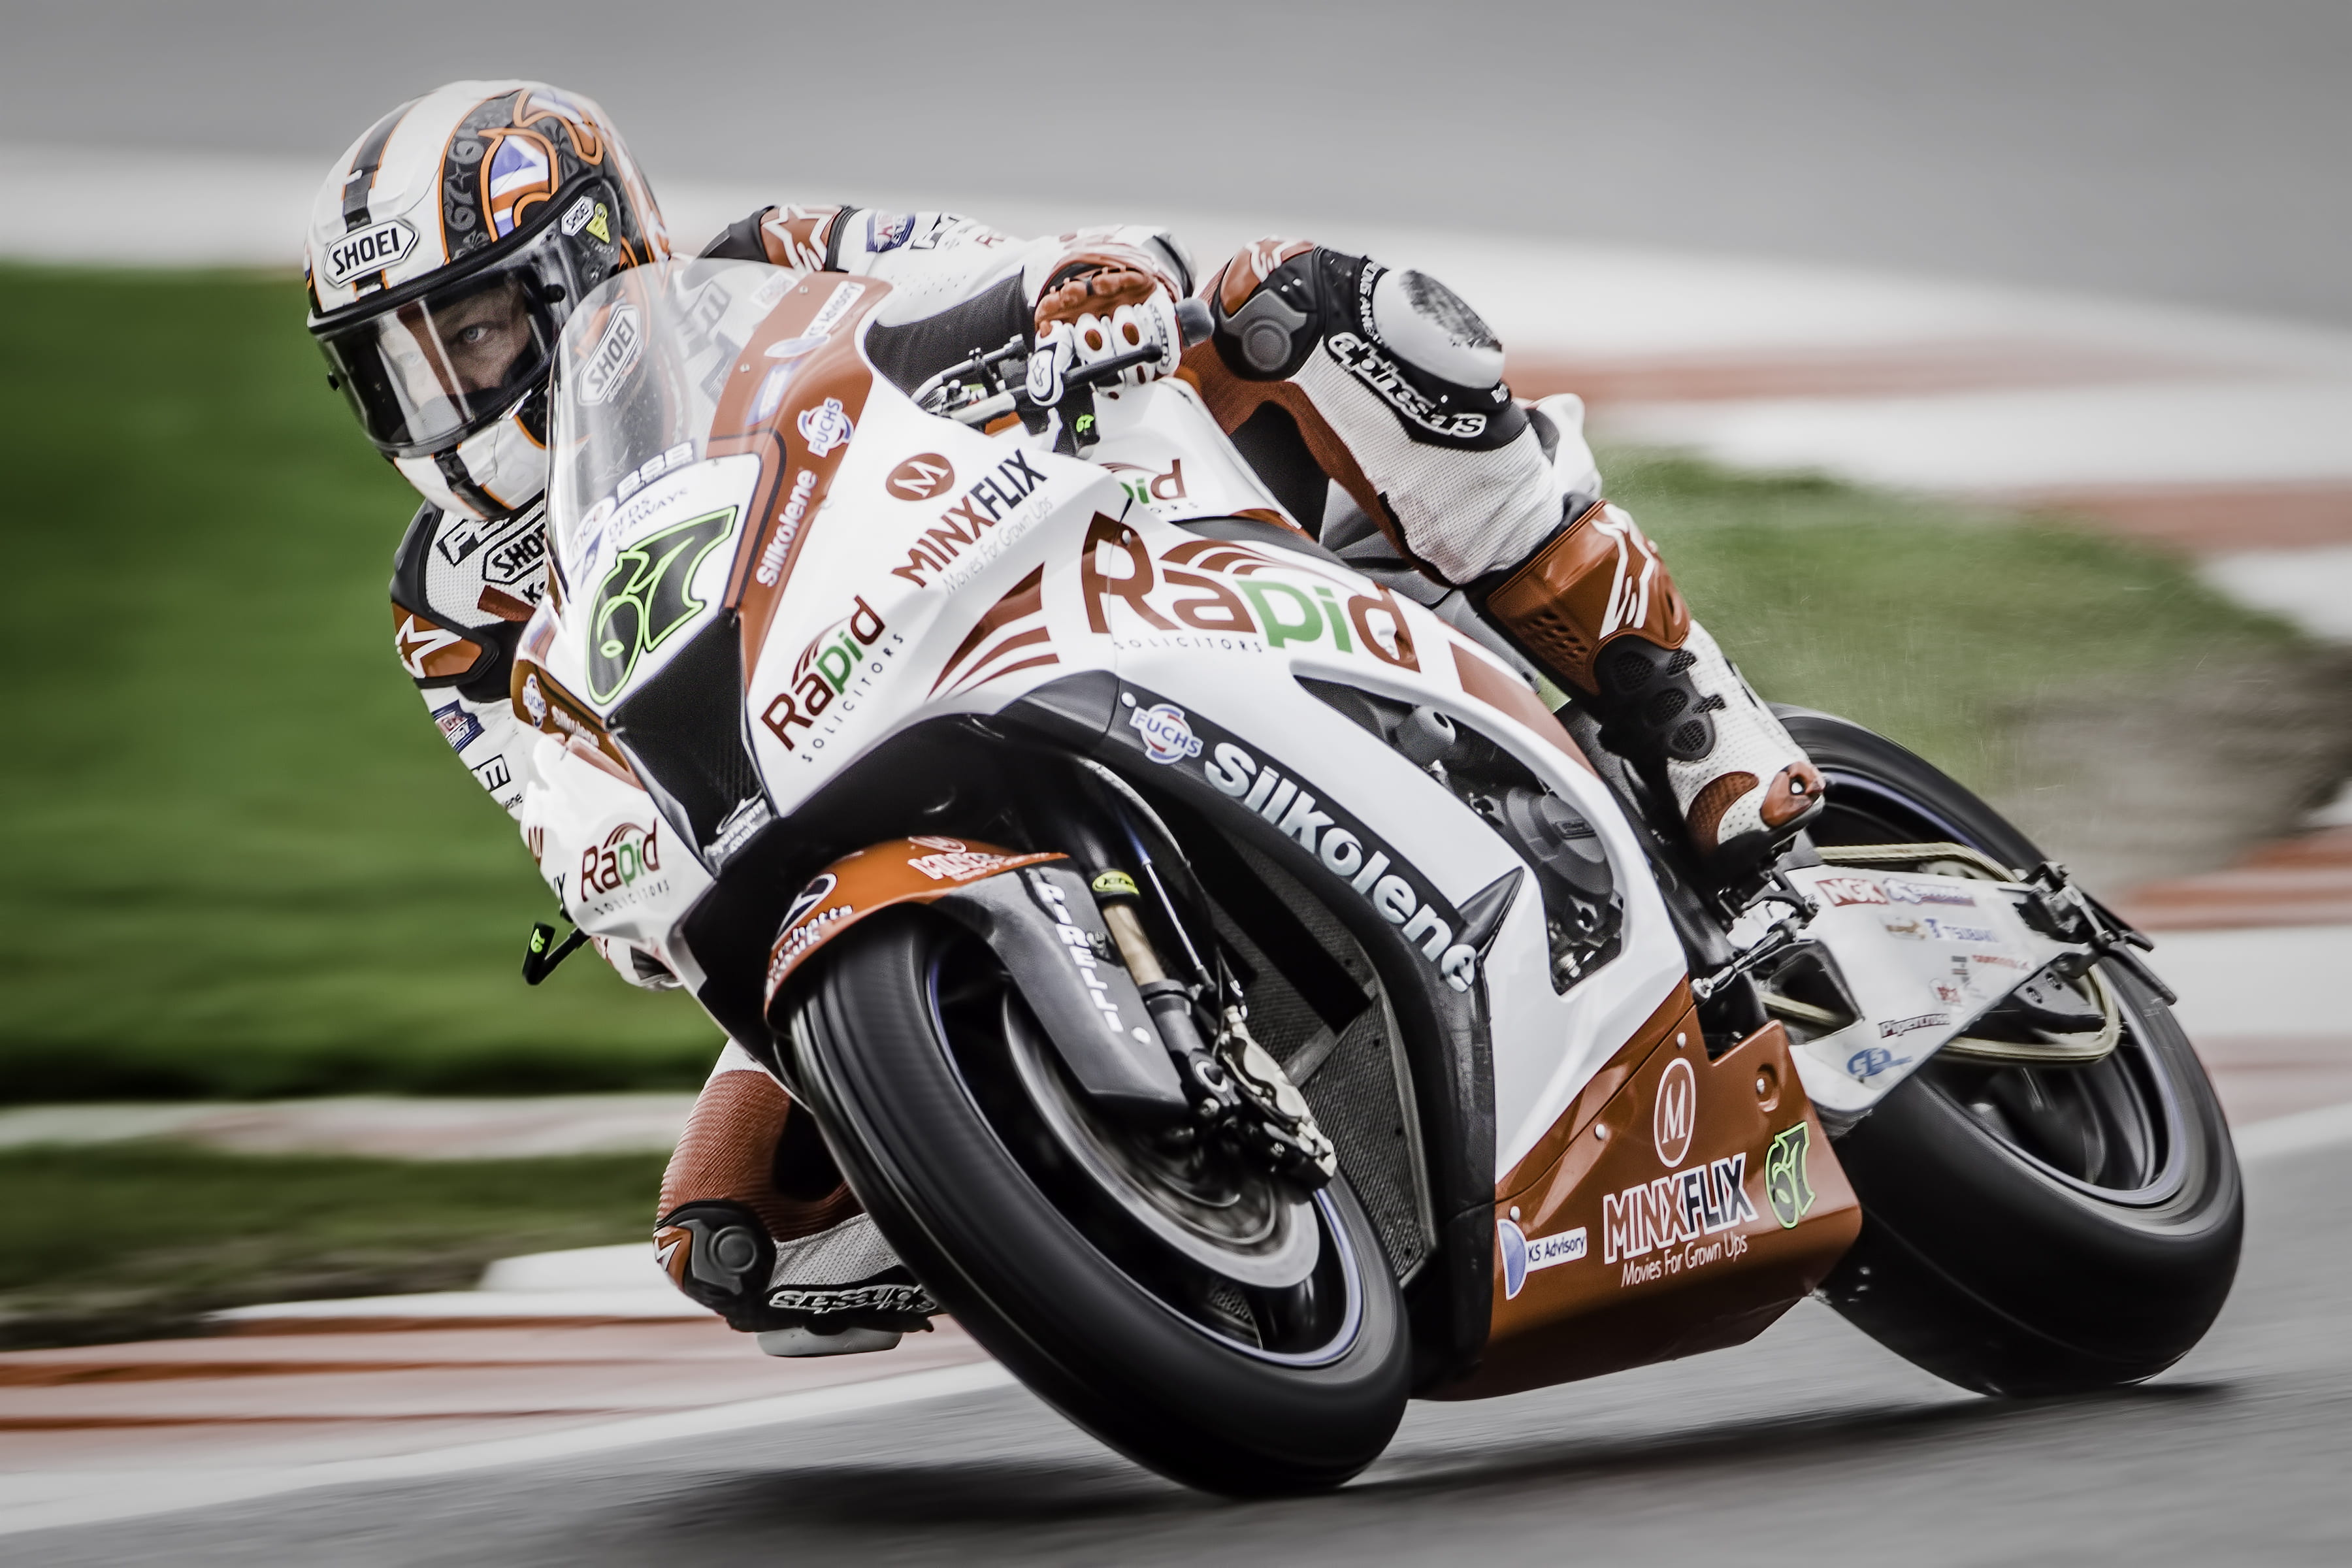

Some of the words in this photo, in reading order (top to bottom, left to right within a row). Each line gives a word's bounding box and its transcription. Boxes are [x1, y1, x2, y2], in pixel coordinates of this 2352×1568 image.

[332, 227, 399, 276] SHOEI
[587, 316, 635, 395] SHOEI
[810, 399, 843, 455] FUCHS
[1076, 414, 1095, 433] 67
[890, 448, 1048, 589] MINXFLIX
[892, 460, 951, 498] M
[755, 468, 818, 587] Silkolene
[943, 557, 985, 595] Movies
[998, 515, 1034, 547] Grown
[1029, 497, 1054, 521] Ups
[587, 504, 740, 706] 67
[1080, 510, 1422, 674] Rapid
[760, 595, 886, 751] Rapid
[1113, 636, 1264, 653] SOLICITORS
[802, 633, 904, 763] SOLICITORS
[1135, 711, 1201, 756] FUCHS
[581, 817, 661, 903] Rapid
[1203, 742, 1478, 992] Silkolene
[1818, 879, 1889, 906] NGK
[530, 928, 546, 954] 67
[1035, 881, 1125, 1033] PIRELLI
[1661, 1078, 1690, 1145] M
[1602, 1152, 1759, 1265] MINXFLIX
[1765, 1120, 1816, 1229] 67
[1527, 1244, 1541, 1264] KS
[1543, 1235, 1586, 1261] Advisory
[1620, 1257, 1663, 1288] Movies
[1663, 1249, 1684, 1274] For
[1684, 1240, 1723, 1271] Grown
[1723, 1231, 1748, 1263] Ups
